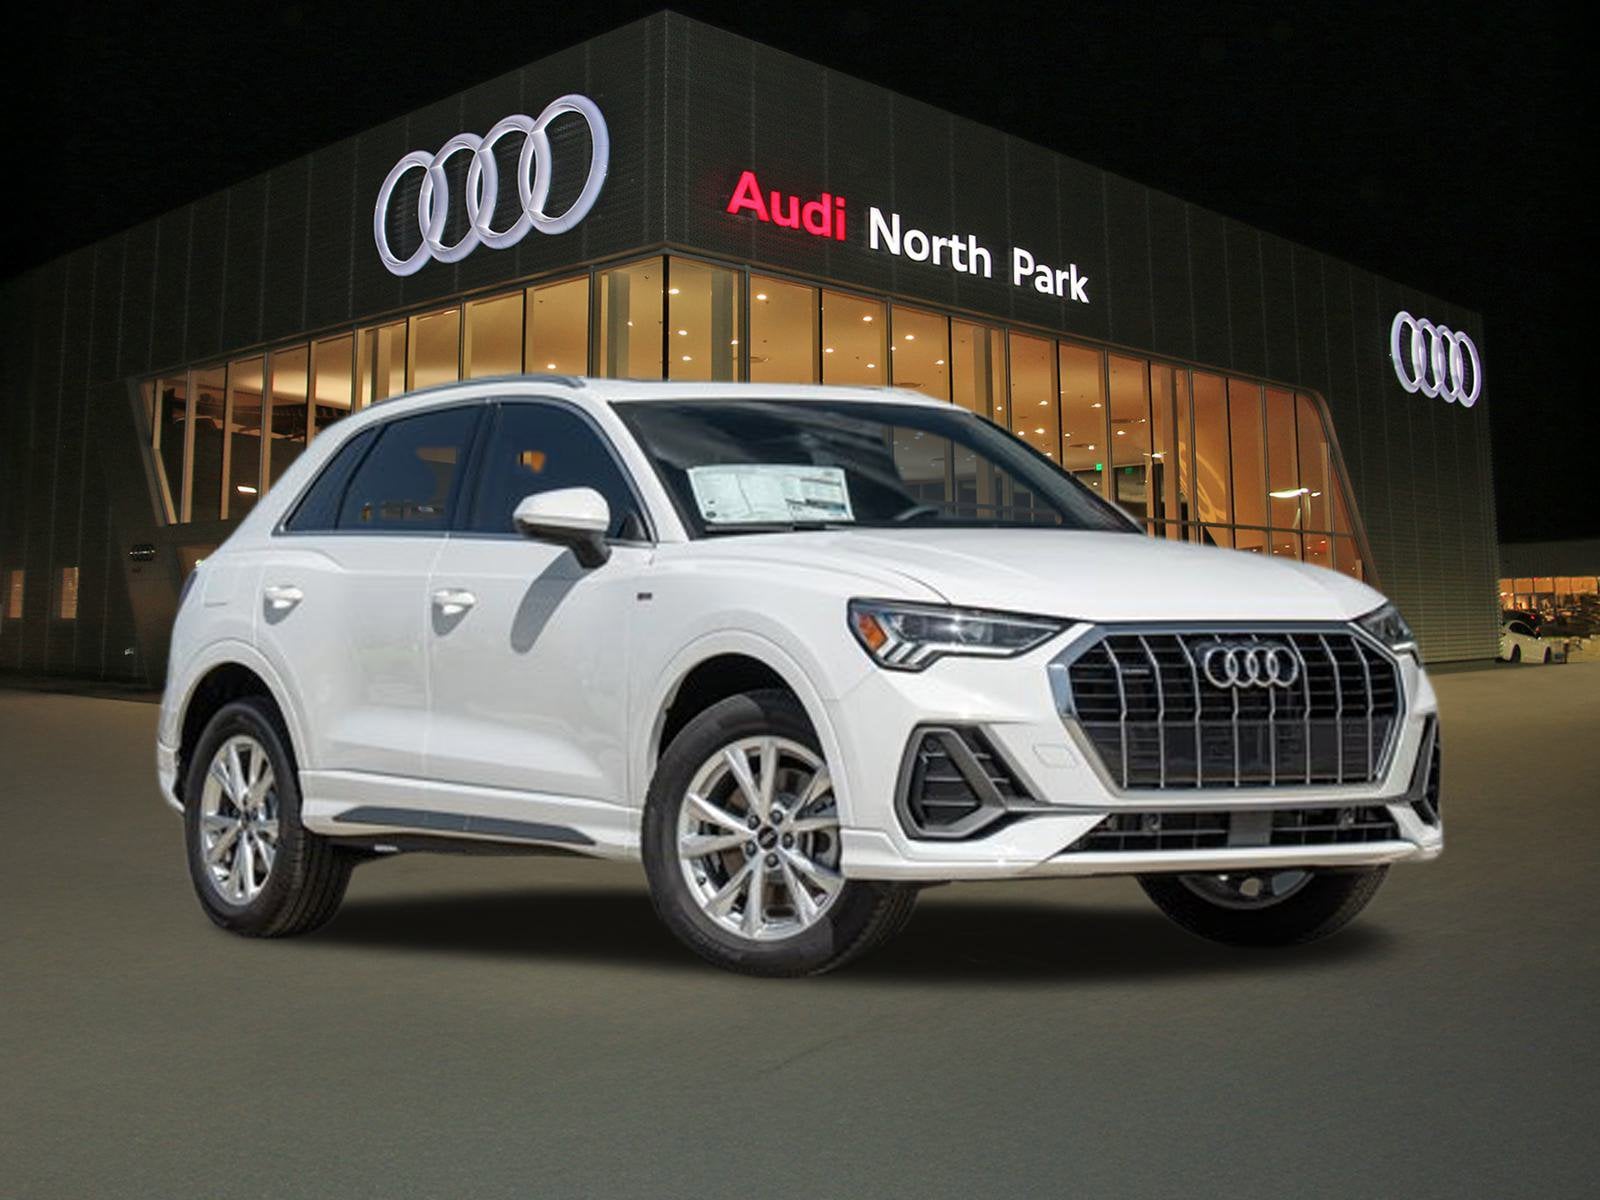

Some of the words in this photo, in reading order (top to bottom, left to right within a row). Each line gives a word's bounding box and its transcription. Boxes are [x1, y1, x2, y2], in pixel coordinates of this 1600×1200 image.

[727, 171, 846, 241] Audi
[868, 206, 992, 278] North
[1012, 247, 1090, 303] Park
